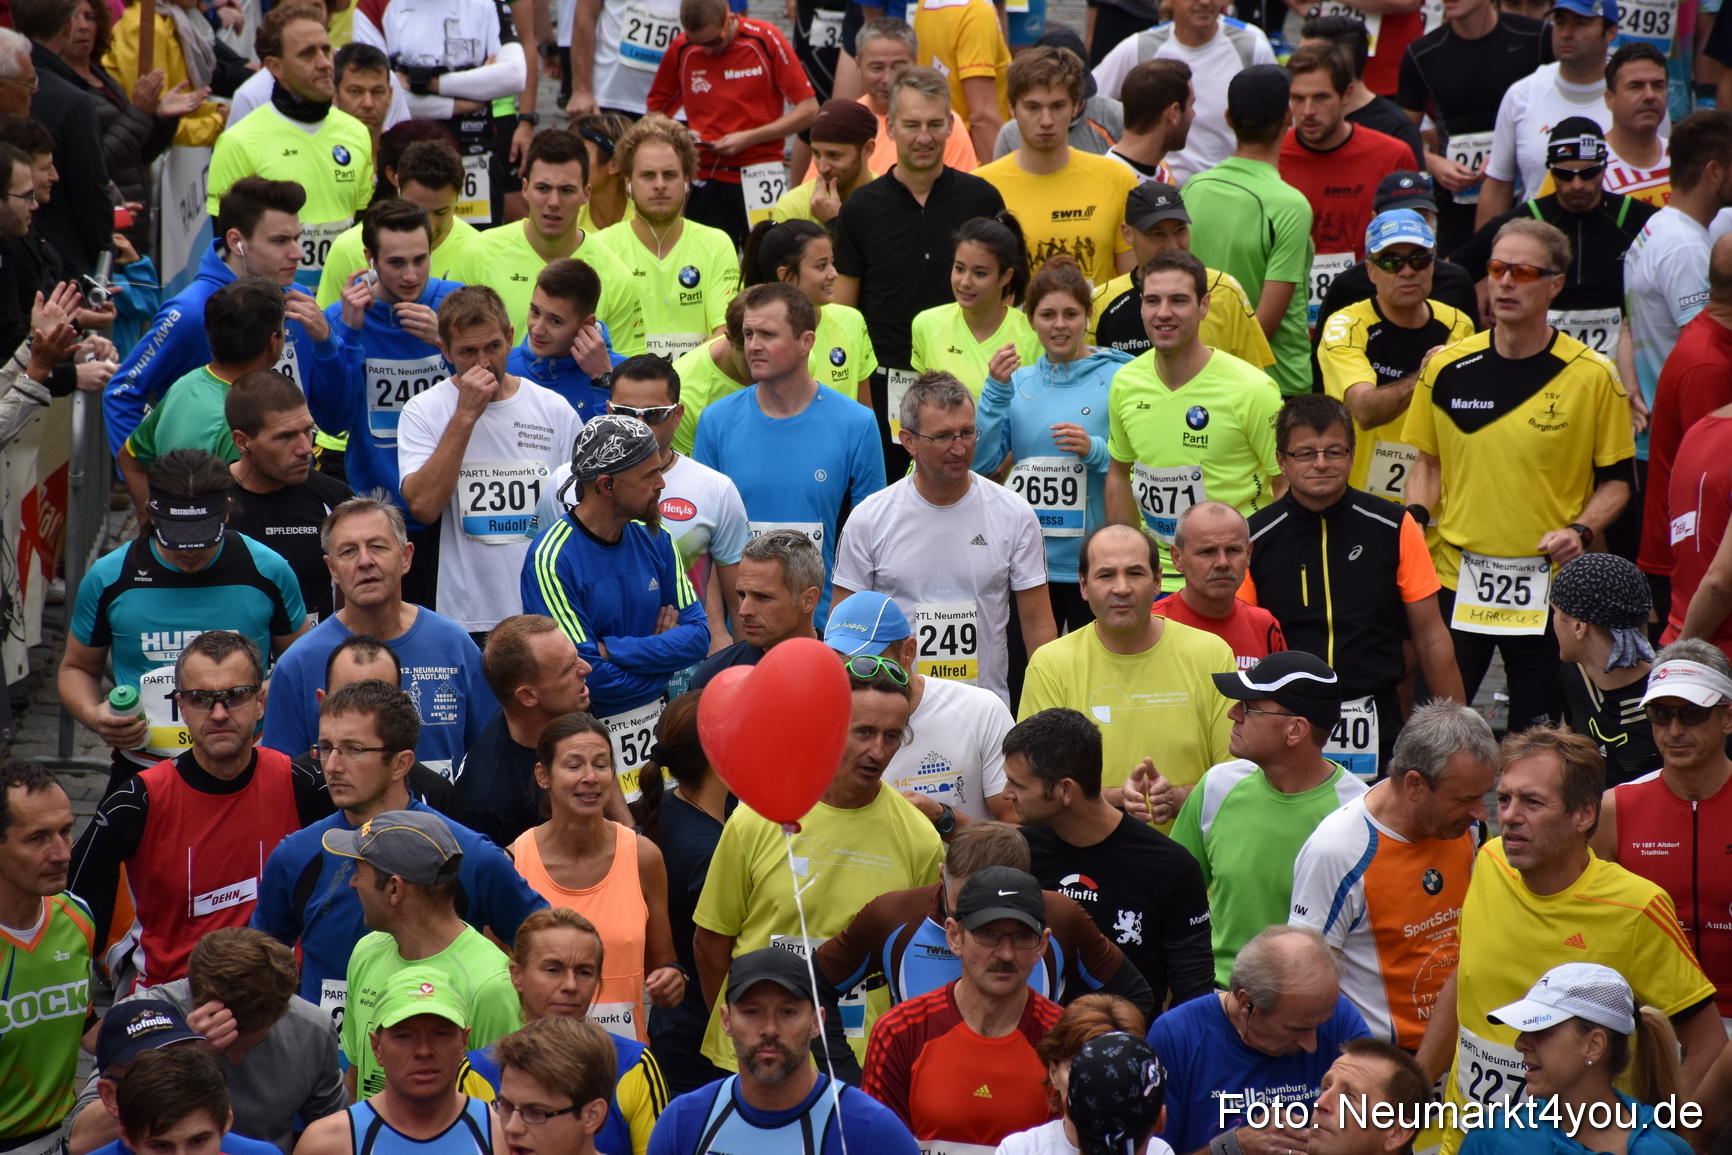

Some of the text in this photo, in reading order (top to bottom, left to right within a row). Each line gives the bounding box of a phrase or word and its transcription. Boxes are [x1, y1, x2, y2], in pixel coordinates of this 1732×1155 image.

[1617, 6, 1670, 35] 2493
[627, 18, 681, 48] 2150
[724, 65, 763, 80] Marcel
[1051, 209, 1082, 219] swn
[680, 292, 704, 302] Partl
[151, 308, 181, 350] BMW
[1111, 338, 1151, 352] Steffen
[368, 365, 438, 376] PARTL Neumarkt
[1372, 361, 1403, 378] Peter
[1544, 391, 1561, 400] TSV
[1450, 398, 1494, 410] Markus
[1527, 417, 1569, 433] Burgthann
[1183, 433, 1209, 445] Partl
[1375, 449, 1404, 461] PARTL
[459, 466, 536, 479] PARTL Neumarkt
[1031, 464, 1071, 474] Neumarkt
[1134, 468, 1189, 483] PARTL Neumarkt
[468, 480, 542, 513] 2301
[1012, 476, 1078, 507] 2659
[1138, 484, 1195, 515] 2671
[169, 506, 208, 516] IRONMAN
[273, 526, 318, 535] PFLEIDERER
[488, 519, 527, 533] Rudolf
[1463, 557, 1535, 572] PARTL Neumarkt
[1477, 573, 1532, 606] 525
[935, 611, 978, 623] Neumarkt
[842, 621, 869, 632] happy
[918, 624, 978, 658] 249
[412, 673, 450, 681] STADTLAUF
[413, 666, 459, 675] NEUMARKTER
[930, 664, 967, 678] Alfred
[630, 710, 660, 726] Neumarkt
[894, 778, 912, 788] 14.
[1657, 841, 1680, 849] Altdorf
[211, 890, 240, 906] DEHN
[1058, 887, 1099, 902] skinfit
[126, 1015, 173, 1035] Hofmühl
[1522, 1014, 1552, 1026] sailfish
[1460, 1036, 1481, 1060] PARTL
[1266, 1083, 1307, 1100] hamburg
